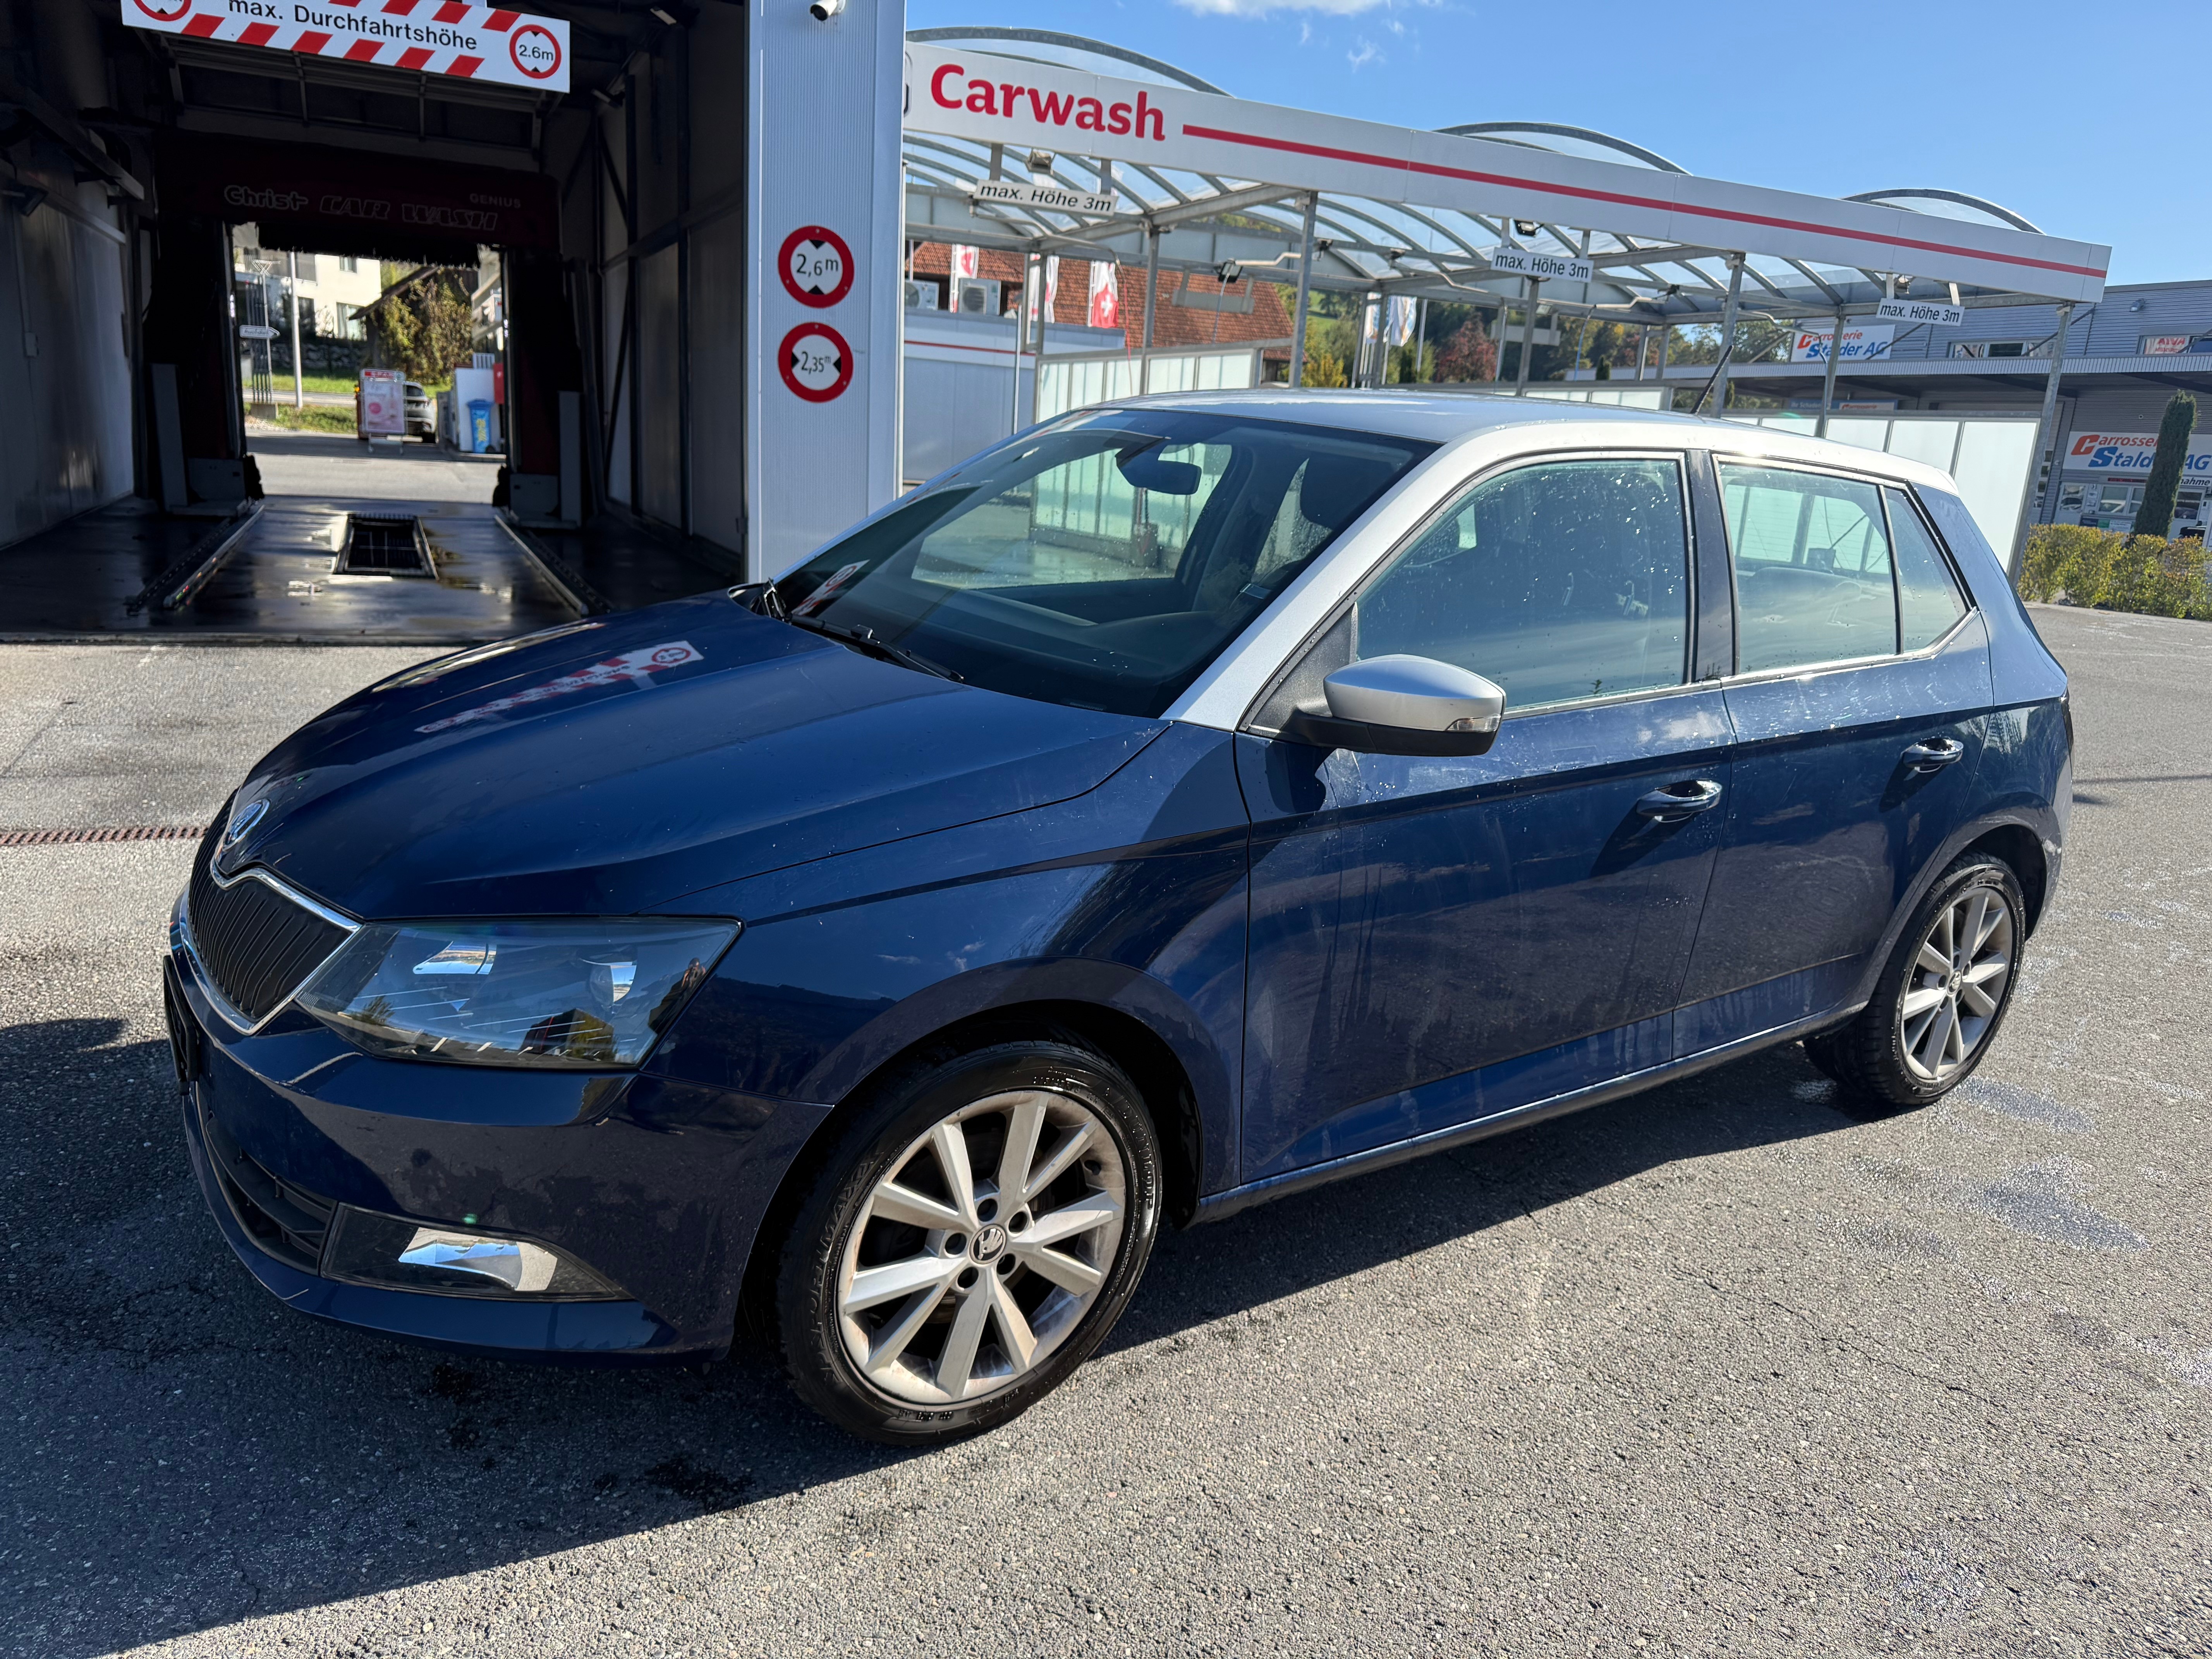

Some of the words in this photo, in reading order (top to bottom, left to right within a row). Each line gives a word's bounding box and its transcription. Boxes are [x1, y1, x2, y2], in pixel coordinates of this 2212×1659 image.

[229, 0, 283, 19] max.
[294, 5, 477, 50] Durchfahrtshöhe
[519, 45, 554, 61] 2.6m
[931, 64, 1165, 141] Carwash
[224, 185, 308, 211] Christ
[470, 193, 521, 208] GENIUS
[980, 185, 1022, 200] max.
[1030, 189, 1078, 207] Höhe
[1083, 197, 1111, 211] 3m
[320, 195, 390, 219] CAR
[402, 203, 498, 230] WASH
[1495, 254, 1526, 270] max.
[1531, 257, 1565, 275] Höhe
[1568, 263, 1589, 278] 3m
[1880, 305, 1905, 317] max.
[1910, 306, 1939, 320] Höhe
[1942, 309, 1960, 323] 3m
[1797, 330, 1863, 349] Carroerie
[1805, 342, 1863, 359] Stader
[2071, 434, 2158, 455] Carrosse
[2088, 447, 2156, 467] Stald
[2185, 454, 2212, 470] AG
